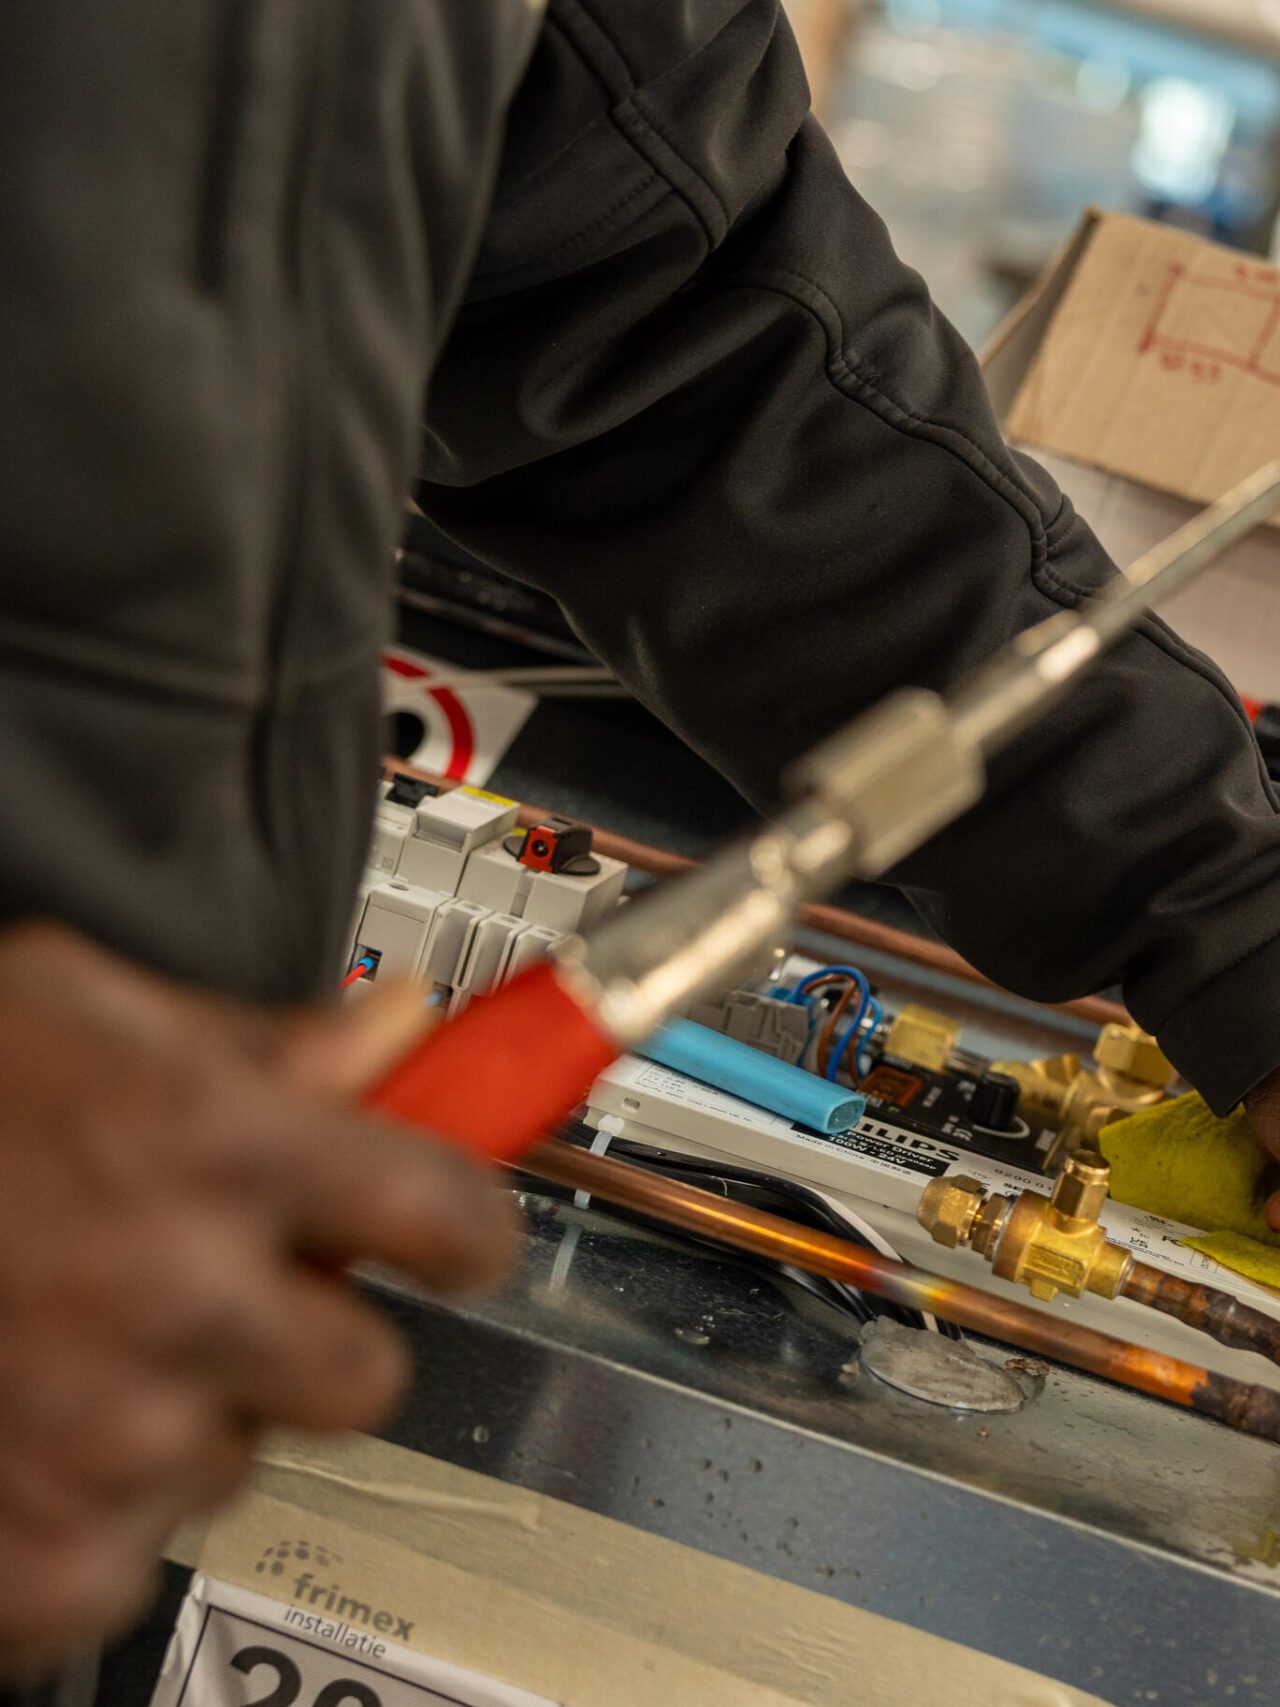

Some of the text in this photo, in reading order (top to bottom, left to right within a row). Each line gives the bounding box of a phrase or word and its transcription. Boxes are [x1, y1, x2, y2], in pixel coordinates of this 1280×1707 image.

[796, 1134, 823, 1145] Made
[836, 1147, 865, 1160] China
[829, 1136, 868, 1151] 100W
[878, 1153, 907, 1165] 24V
[847, 1131, 890, 1149] Power
[892, 1145, 934, 1163] Driver
[860, 1123, 960, 1161] ILIPS
[293, 1573, 417, 1642] frimex
[283, 1606, 387, 1660] installatie
